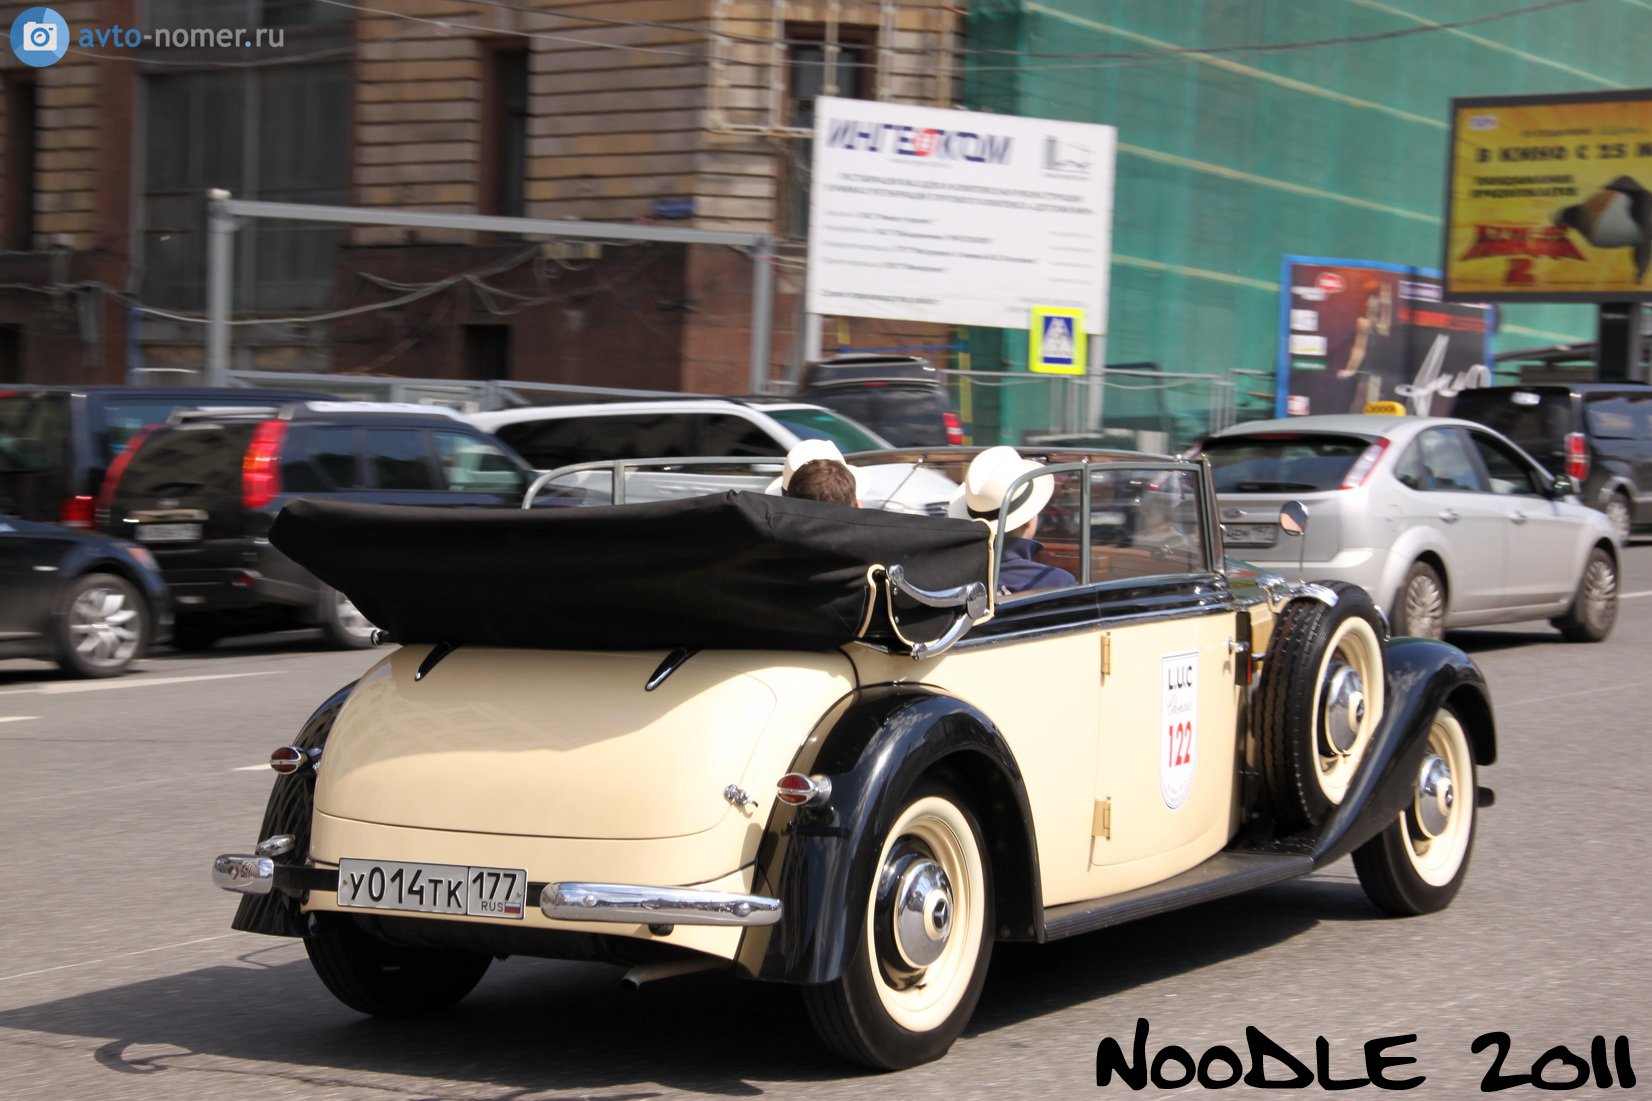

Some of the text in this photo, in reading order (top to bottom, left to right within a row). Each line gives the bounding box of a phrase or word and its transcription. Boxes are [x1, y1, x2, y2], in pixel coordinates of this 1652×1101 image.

[1168, 721, 1193, 768] 122
[350, 866, 517, 909] У014ТК 177
[481, 901, 504, 913] RUS
